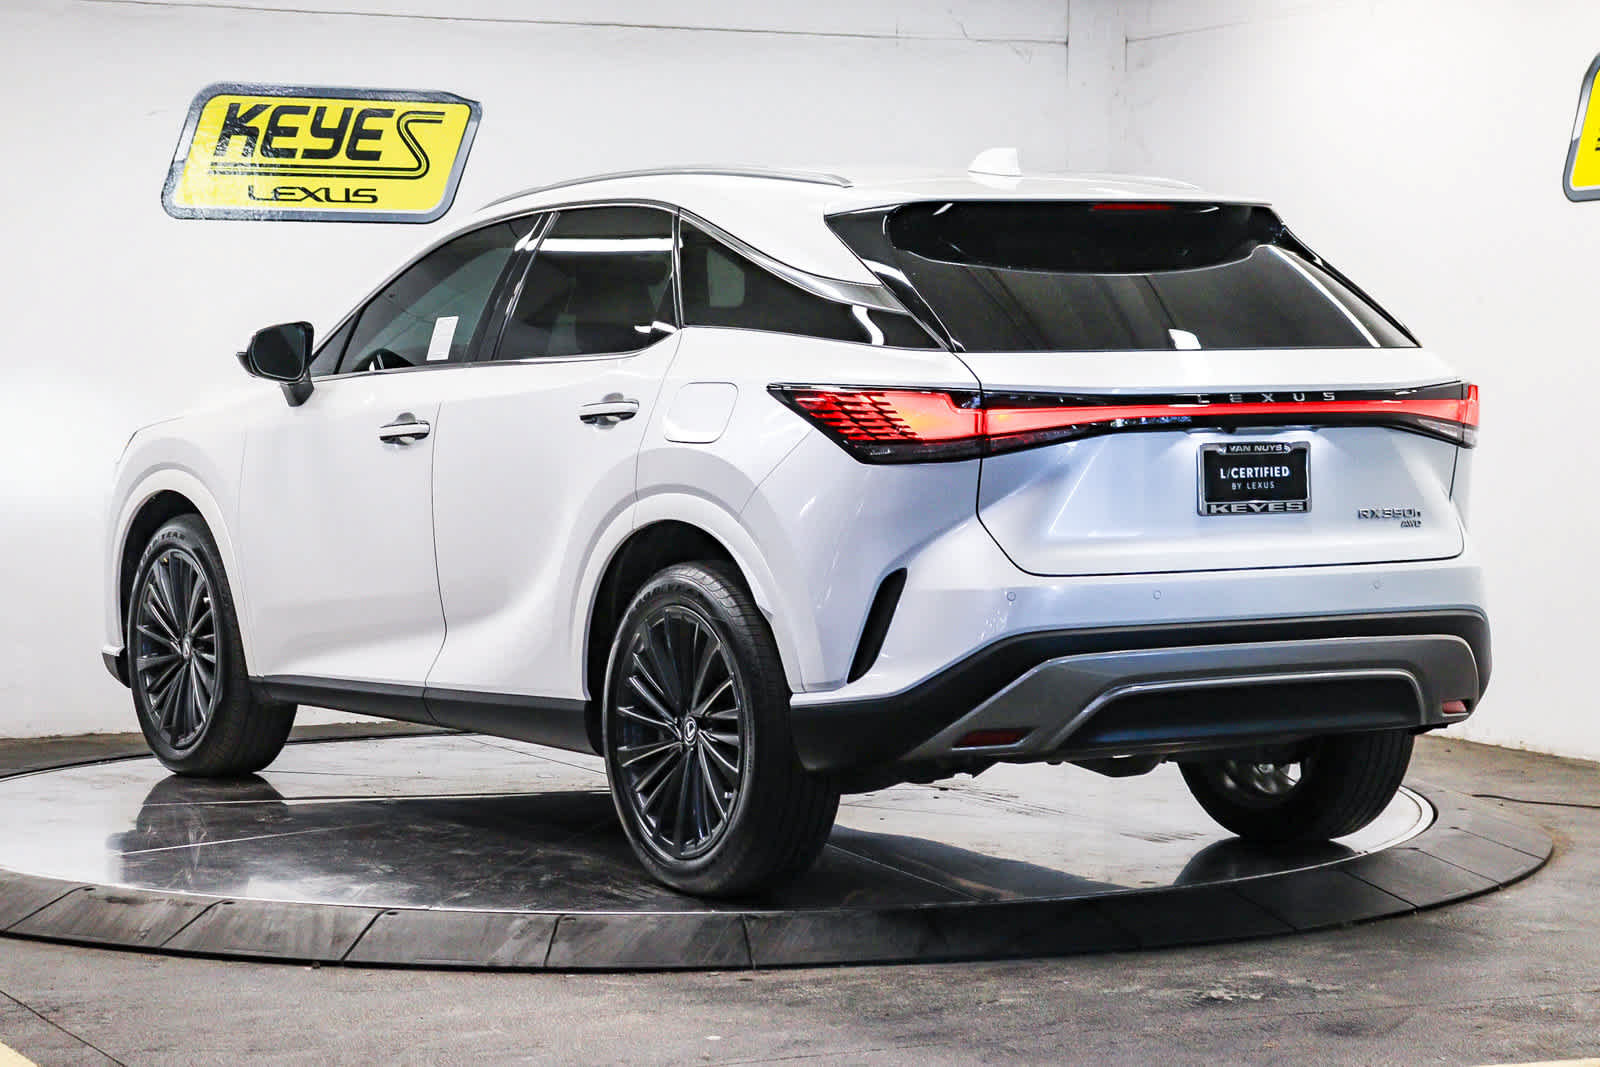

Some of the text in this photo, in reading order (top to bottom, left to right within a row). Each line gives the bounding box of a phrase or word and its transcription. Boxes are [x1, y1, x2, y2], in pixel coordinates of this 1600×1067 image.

[210, 102, 445, 179] KEYES
[247, 184, 378, 204] LEXUS
[1197, 392, 1336, 404] LEXUS
[1229, 444, 1282, 453] VAN NUYS
[1220, 466, 1290, 479] L/CERTIFIED
[1231, 480, 1275, 490] BY LEXUS
[1210, 501, 1304, 514] KEYES
